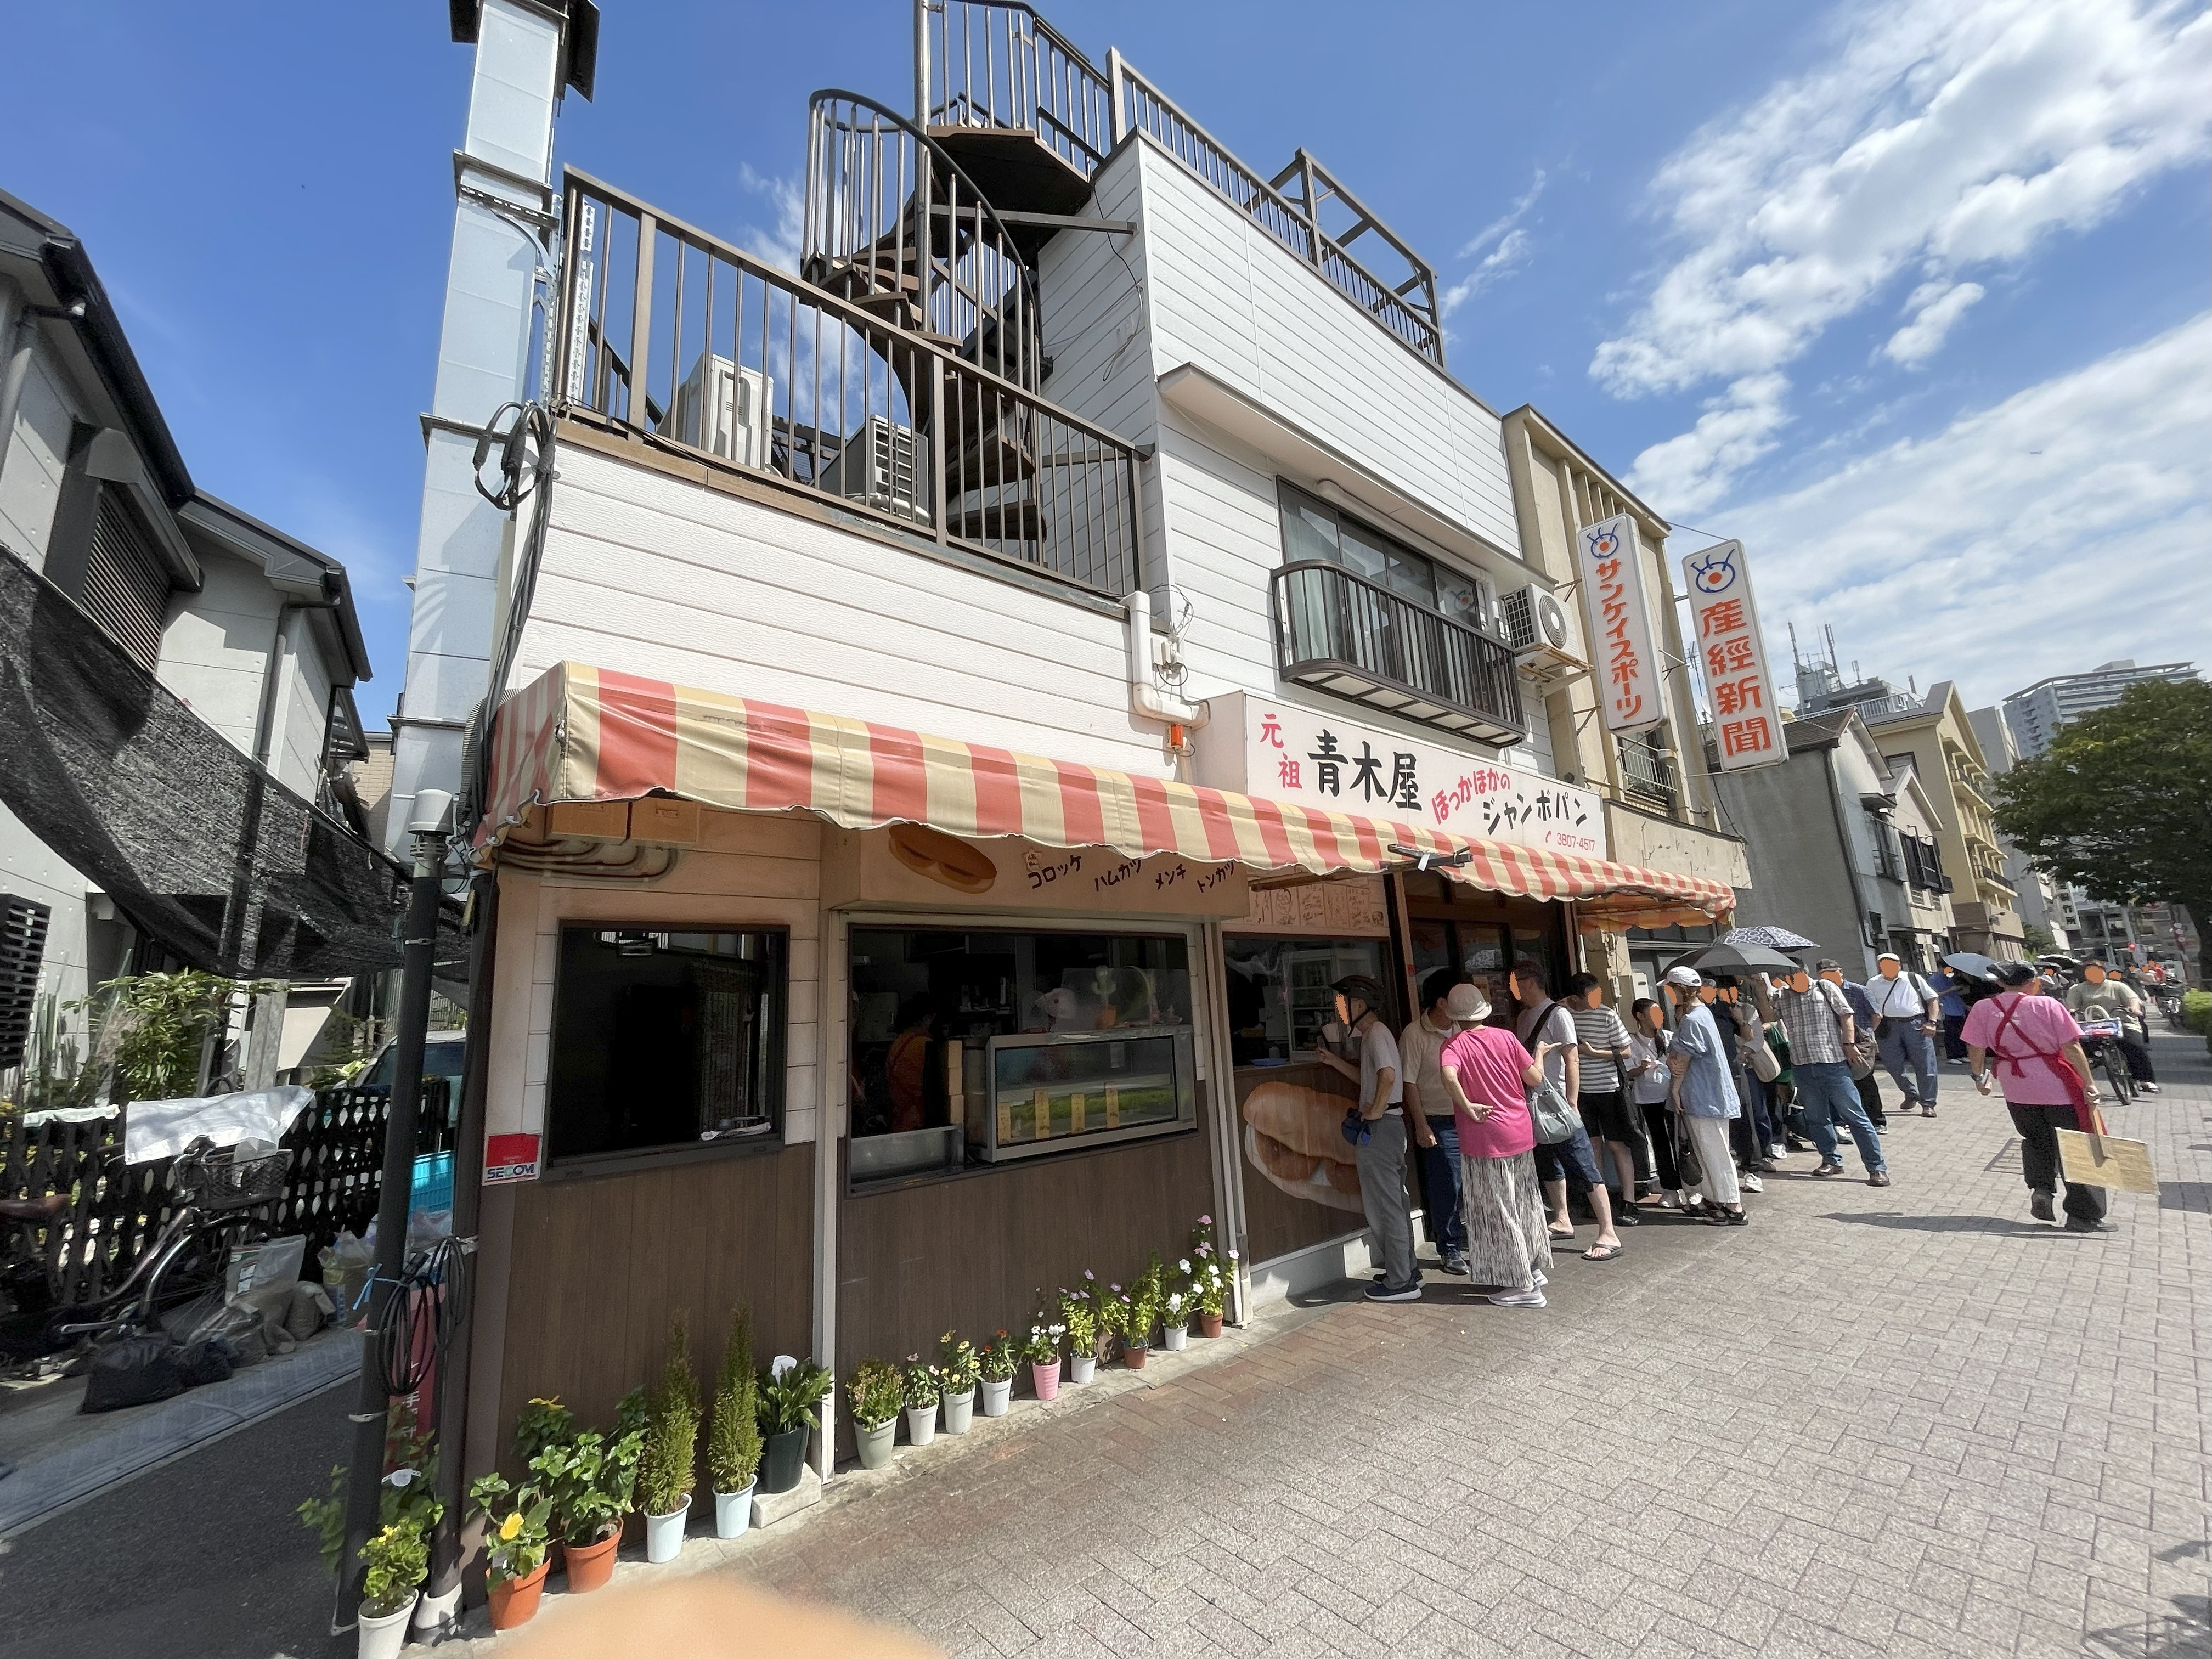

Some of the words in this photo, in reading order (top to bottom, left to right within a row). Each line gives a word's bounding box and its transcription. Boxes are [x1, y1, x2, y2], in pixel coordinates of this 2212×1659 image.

[1595, 558, 1643, 720] サンケイスポーツ
[1699, 597, 1771, 758] 産經新聞
[1260, 713, 1302, 789] 元祖
[1307, 729, 1423, 812] 青木屋
[1431, 767, 1511, 825] ほっかほかの
[1482, 789, 1588, 836] ジャンボパン
[1556, 832, 1595, 851] 3807-4517
[1027, 854, 1082, 889] コロッケ
[1094, 859, 1142, 891] ハムカツ
[1154, 863, 1187, 890] メンチ
[1196, 861, 1235, 894] トンカツ
[487, 1164, 535, 1180] SECOM
